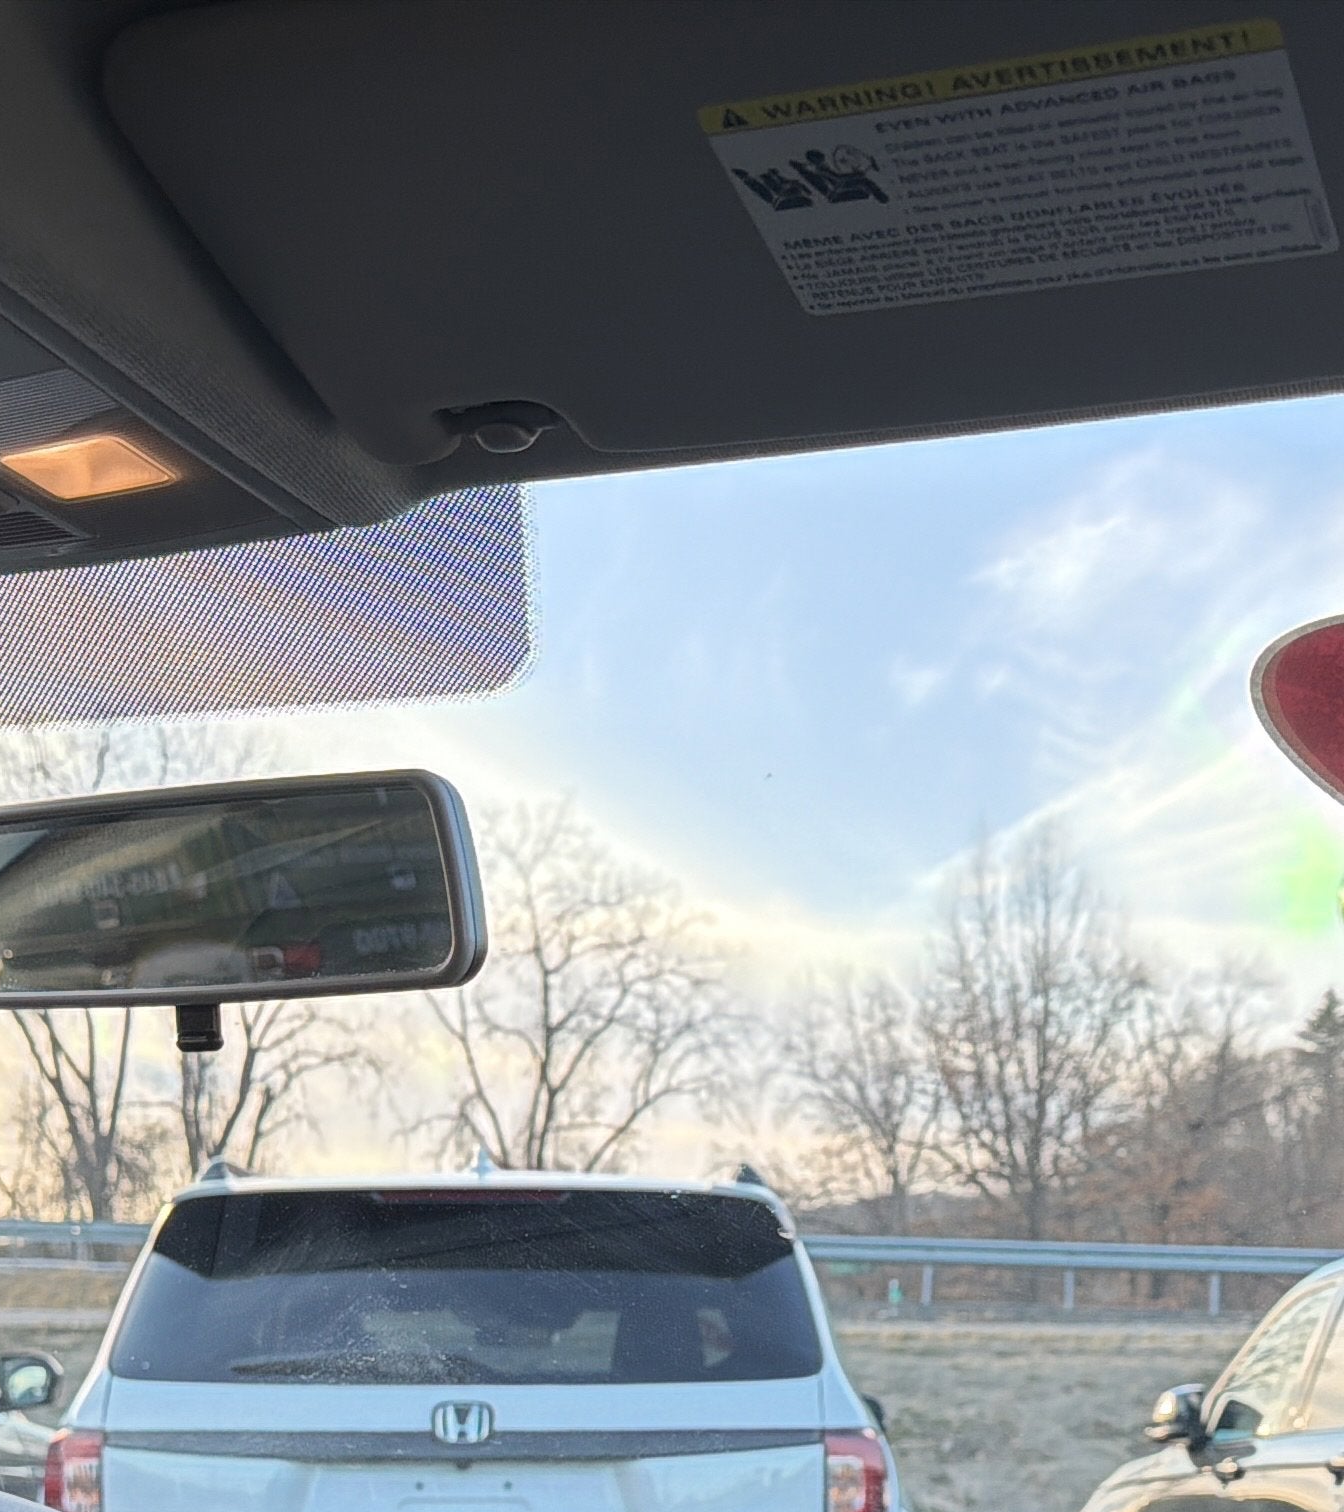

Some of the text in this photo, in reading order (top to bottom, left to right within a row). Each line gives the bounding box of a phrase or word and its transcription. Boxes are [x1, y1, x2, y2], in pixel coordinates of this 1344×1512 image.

[761, 28, 1249, 118] WARNING! AVERTISSEMENT!
[872, 67, 1237, 134] EVEN WITH ADVANCED AIR BAGS
[846, 225, 901, 243] AVEC
